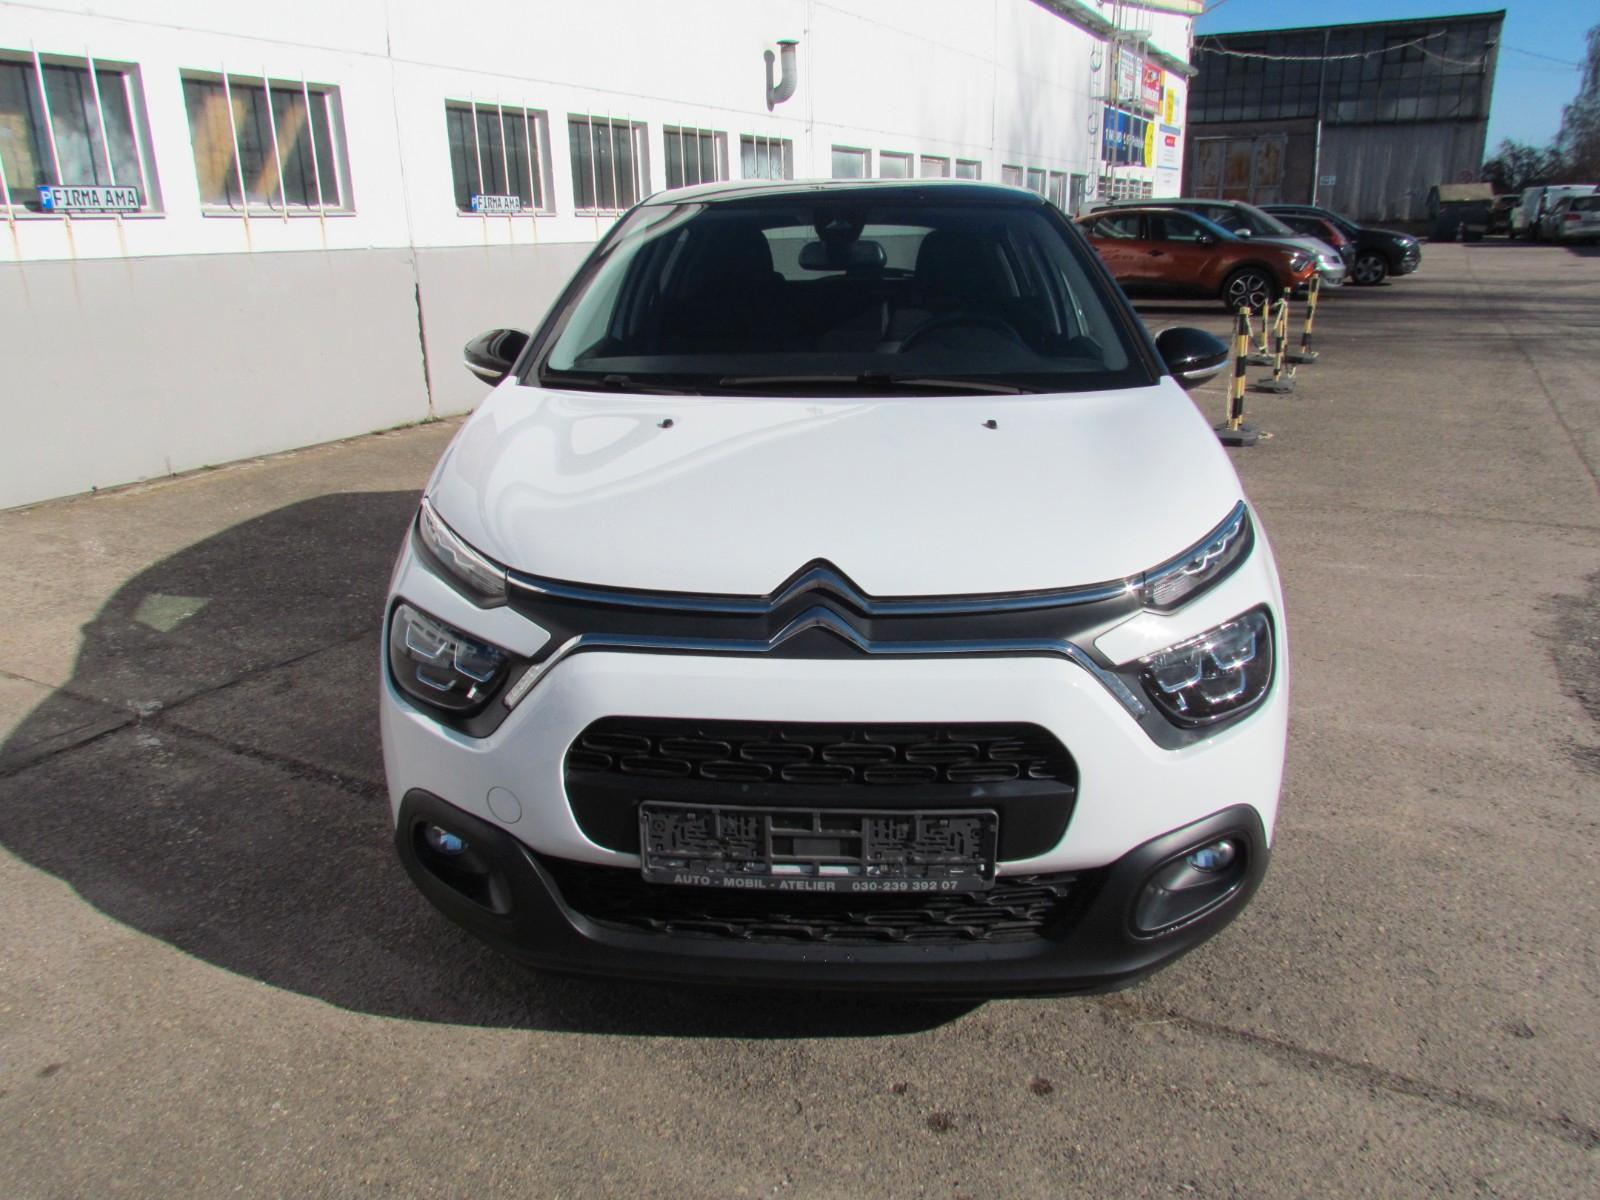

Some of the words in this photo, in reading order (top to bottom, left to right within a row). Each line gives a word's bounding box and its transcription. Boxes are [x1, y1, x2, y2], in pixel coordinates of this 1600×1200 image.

[52, 189, 101, 206] FIRMA
[105, 190, 137, 207] AMA
[477, 196, 502, 209] FIRMA
[504, 197, 520, 209] AMA
[674, 874, 711, 886] AUTO
[723, 877, 767, 889] MOBIL
[779, 880, 836, 891] ATELIER
[852, 881, 908, 891] 030-239
[912, 881, 938, 891] 392
[941, 881, 958, 891] 07
